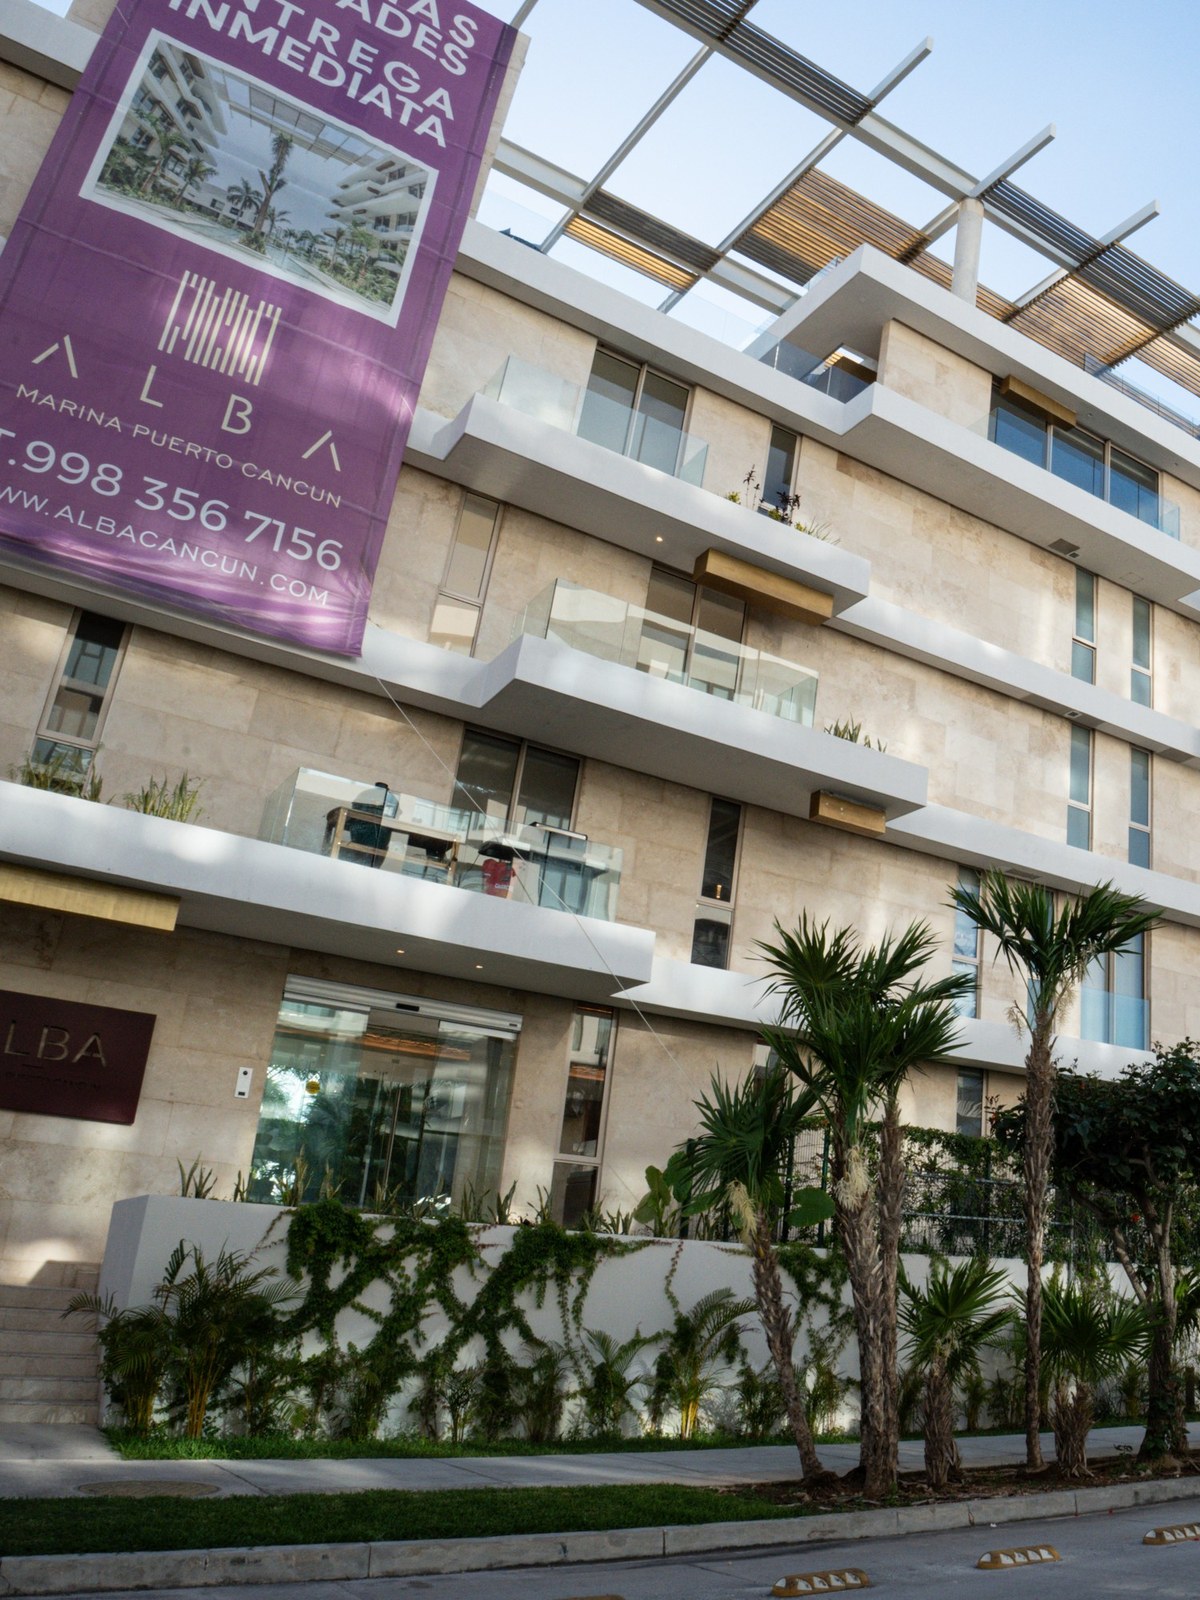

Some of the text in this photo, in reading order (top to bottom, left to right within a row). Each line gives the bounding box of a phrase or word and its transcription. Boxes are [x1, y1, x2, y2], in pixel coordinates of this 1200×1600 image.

[388, 0, 478, 48] AS
[16, 383, 342, 509] MARINA PUERTO CANCUN
[31, 334, 341, 472] ALBA
[135, 476, 229, 532] 356
[244, 511, 344, 571] 7156
[4, 1020, 107, 1067] LBA
